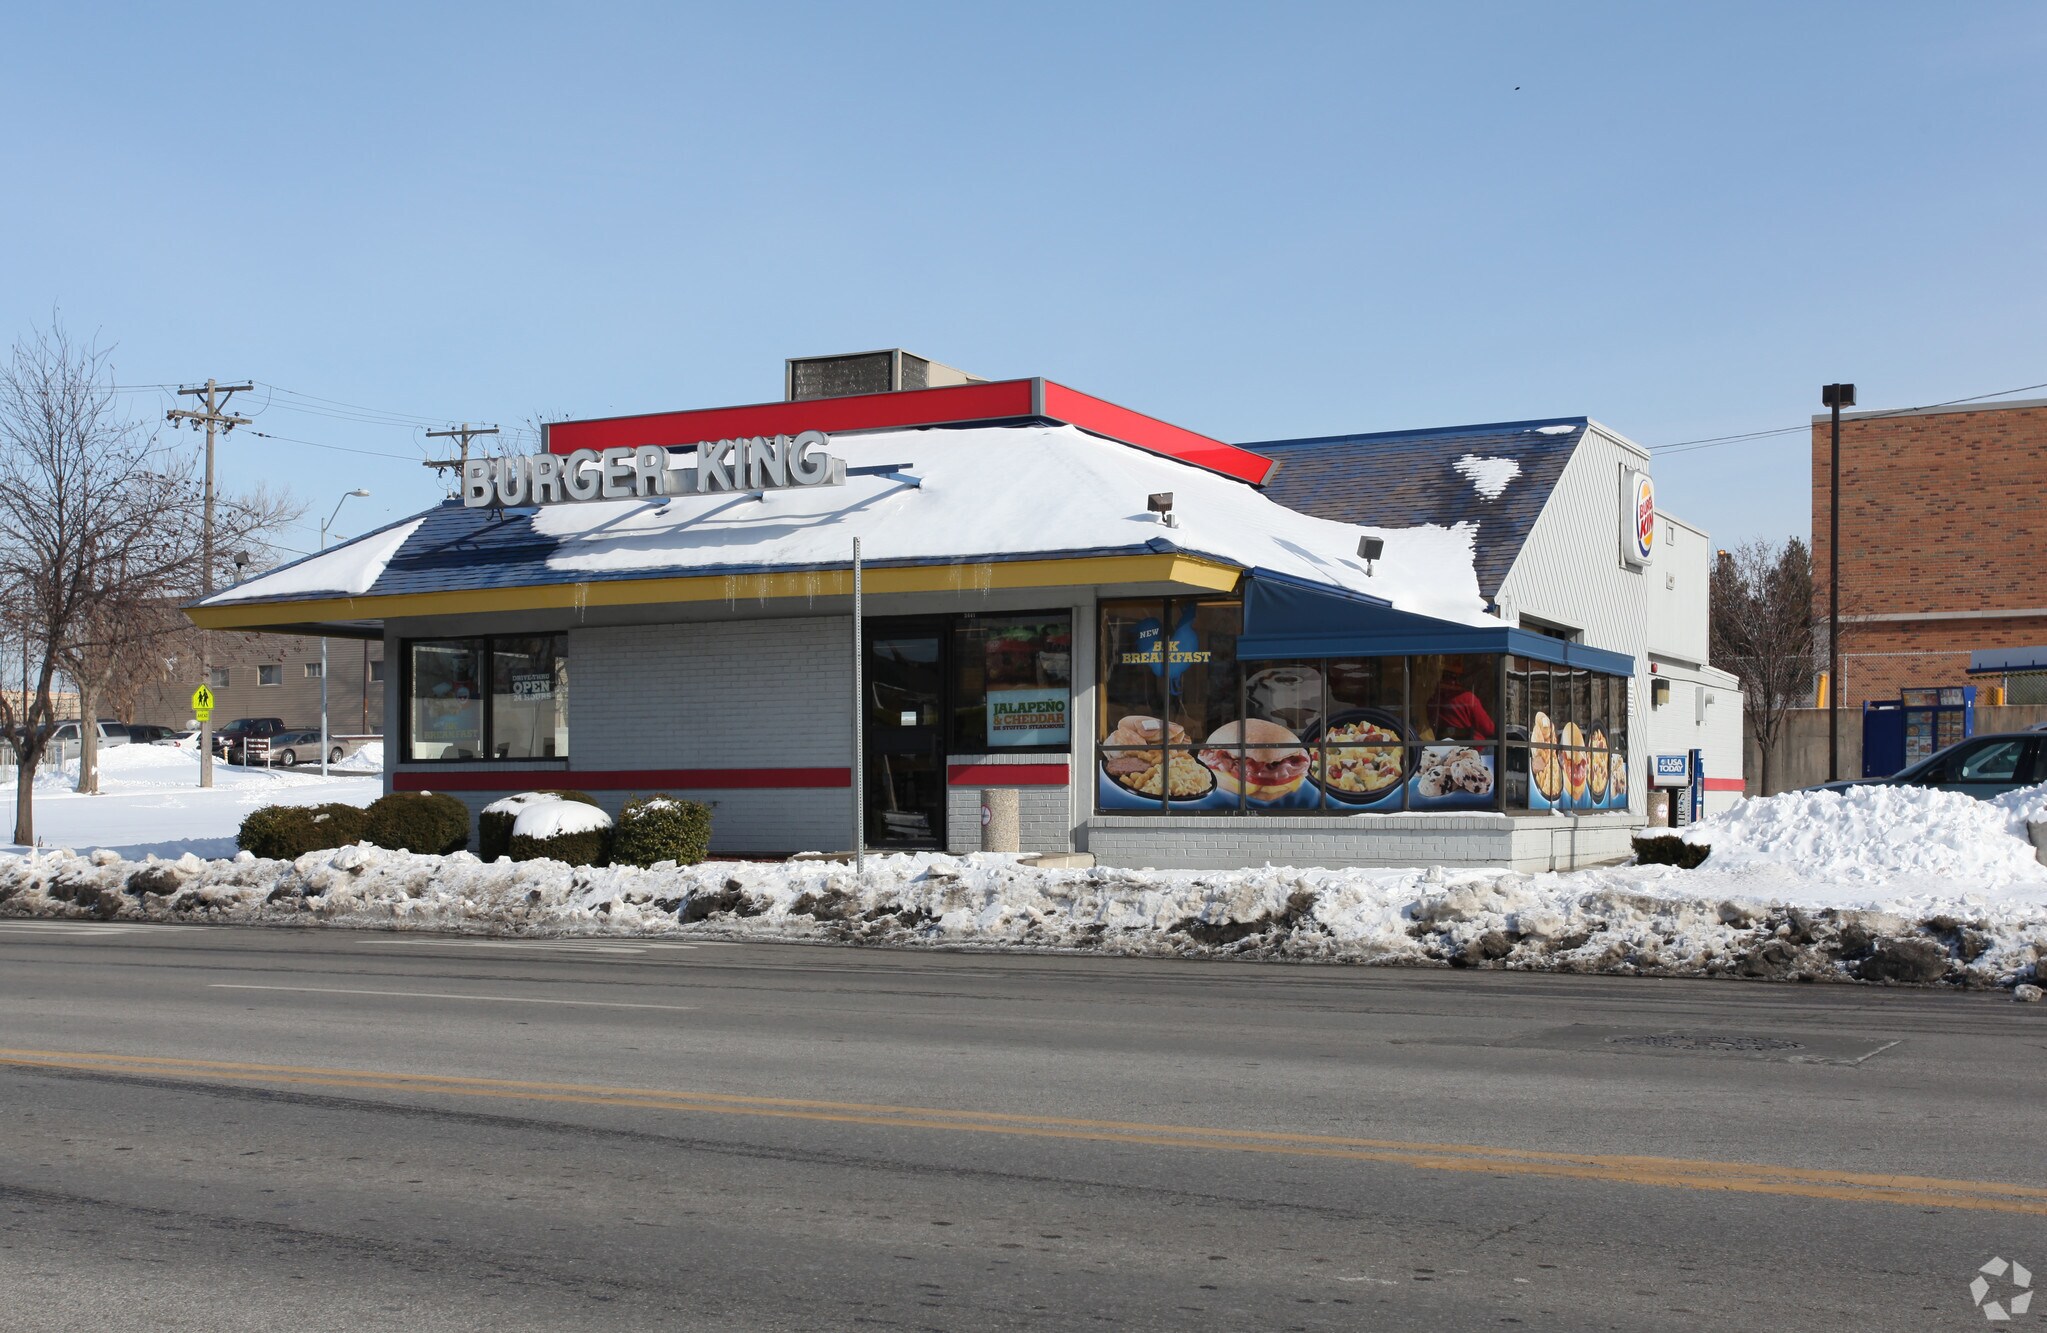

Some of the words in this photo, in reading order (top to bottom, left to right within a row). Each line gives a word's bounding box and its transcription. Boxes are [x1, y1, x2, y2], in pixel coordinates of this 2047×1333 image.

[464, 444, 669, 508] BURGER
[697, 430, 833, 493] KING
[1640, 512, 1653, 539] KIN
[1139, 628, 1160, 639] NEW
[513, 680, 551, 694] OPEN
[524, 692, 551, 701] HOURS
[993, 698, 1065, 715] JALAPEÑO
[993, 714, 1002, 725] &
[1004, 713, 1065, 725] CHEDDAR
[1667, 758, 1683, 766] USA
[1659, 765, 1683, 773] TODAY
